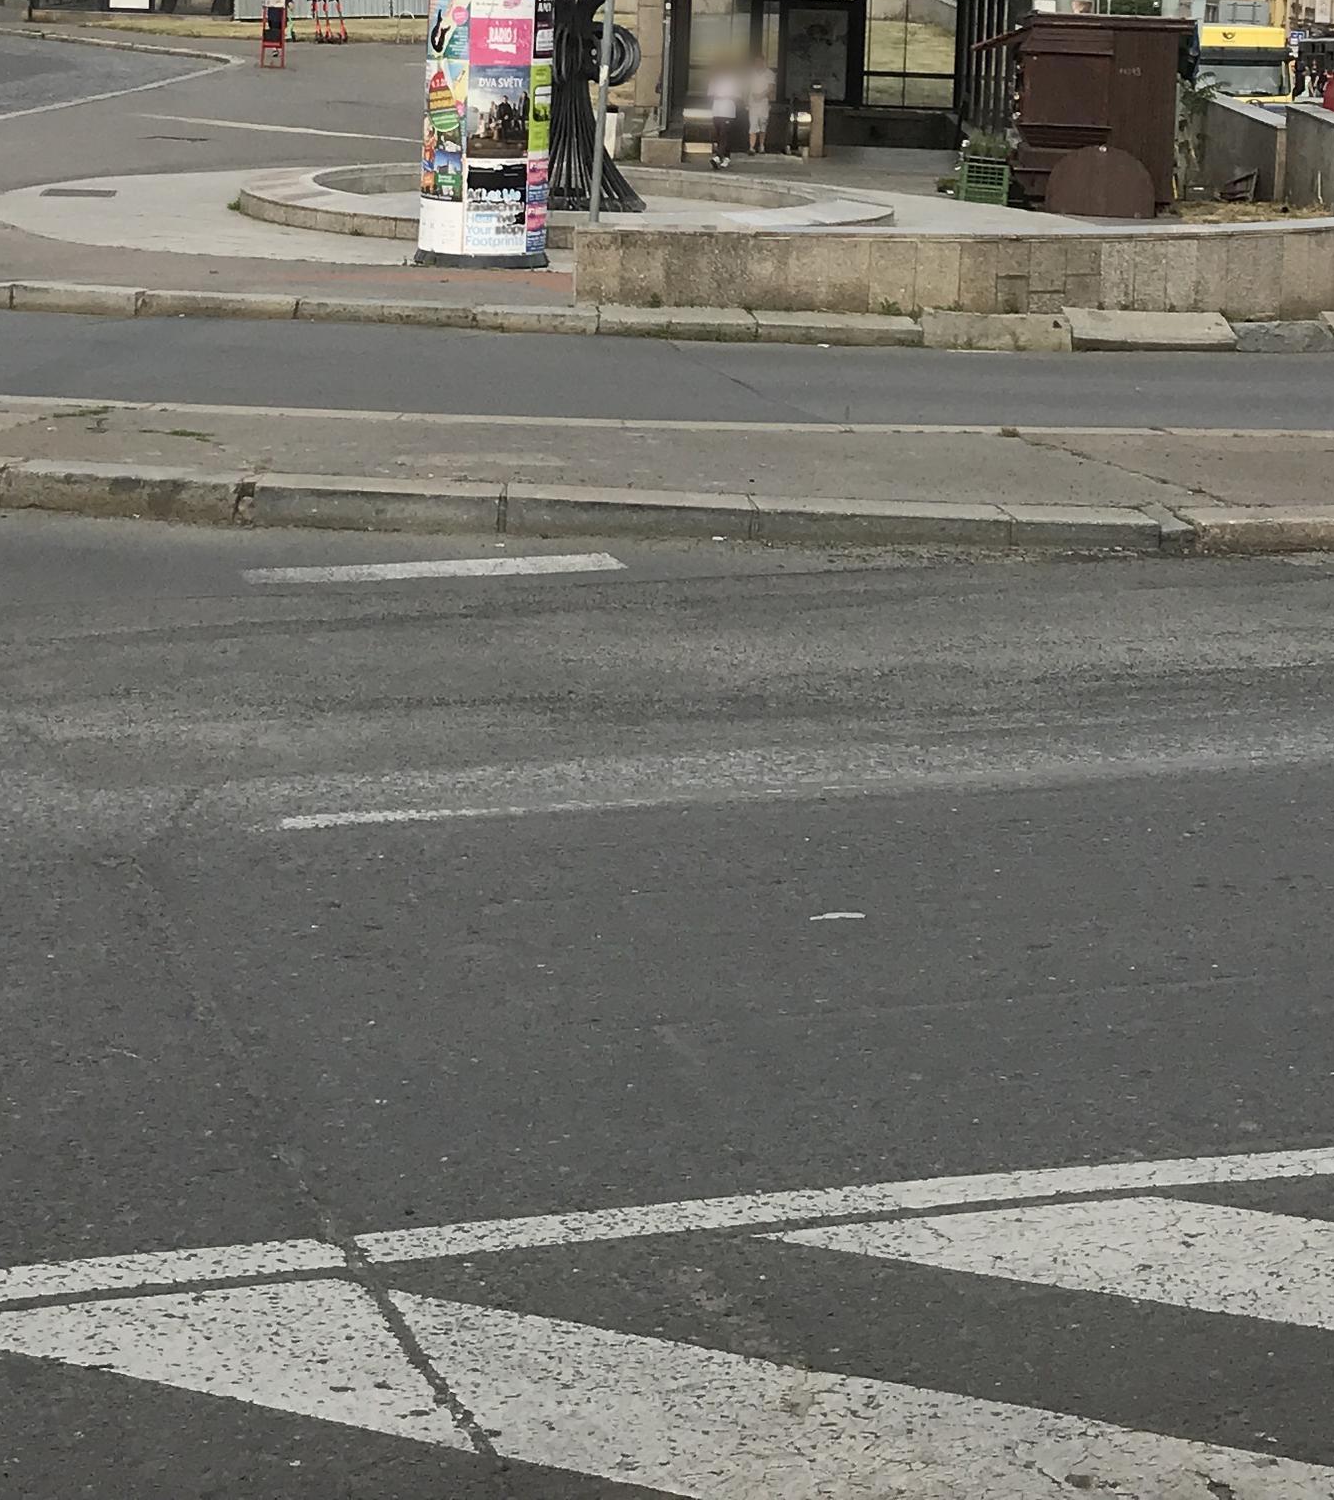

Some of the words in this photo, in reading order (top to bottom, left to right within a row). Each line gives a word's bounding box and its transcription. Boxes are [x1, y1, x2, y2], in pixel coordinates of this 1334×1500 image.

[488, 26, 513, 43] RADIO
[479, 77, 497, 88] DVA
[498, 76, 524, 88] SVĚTY
